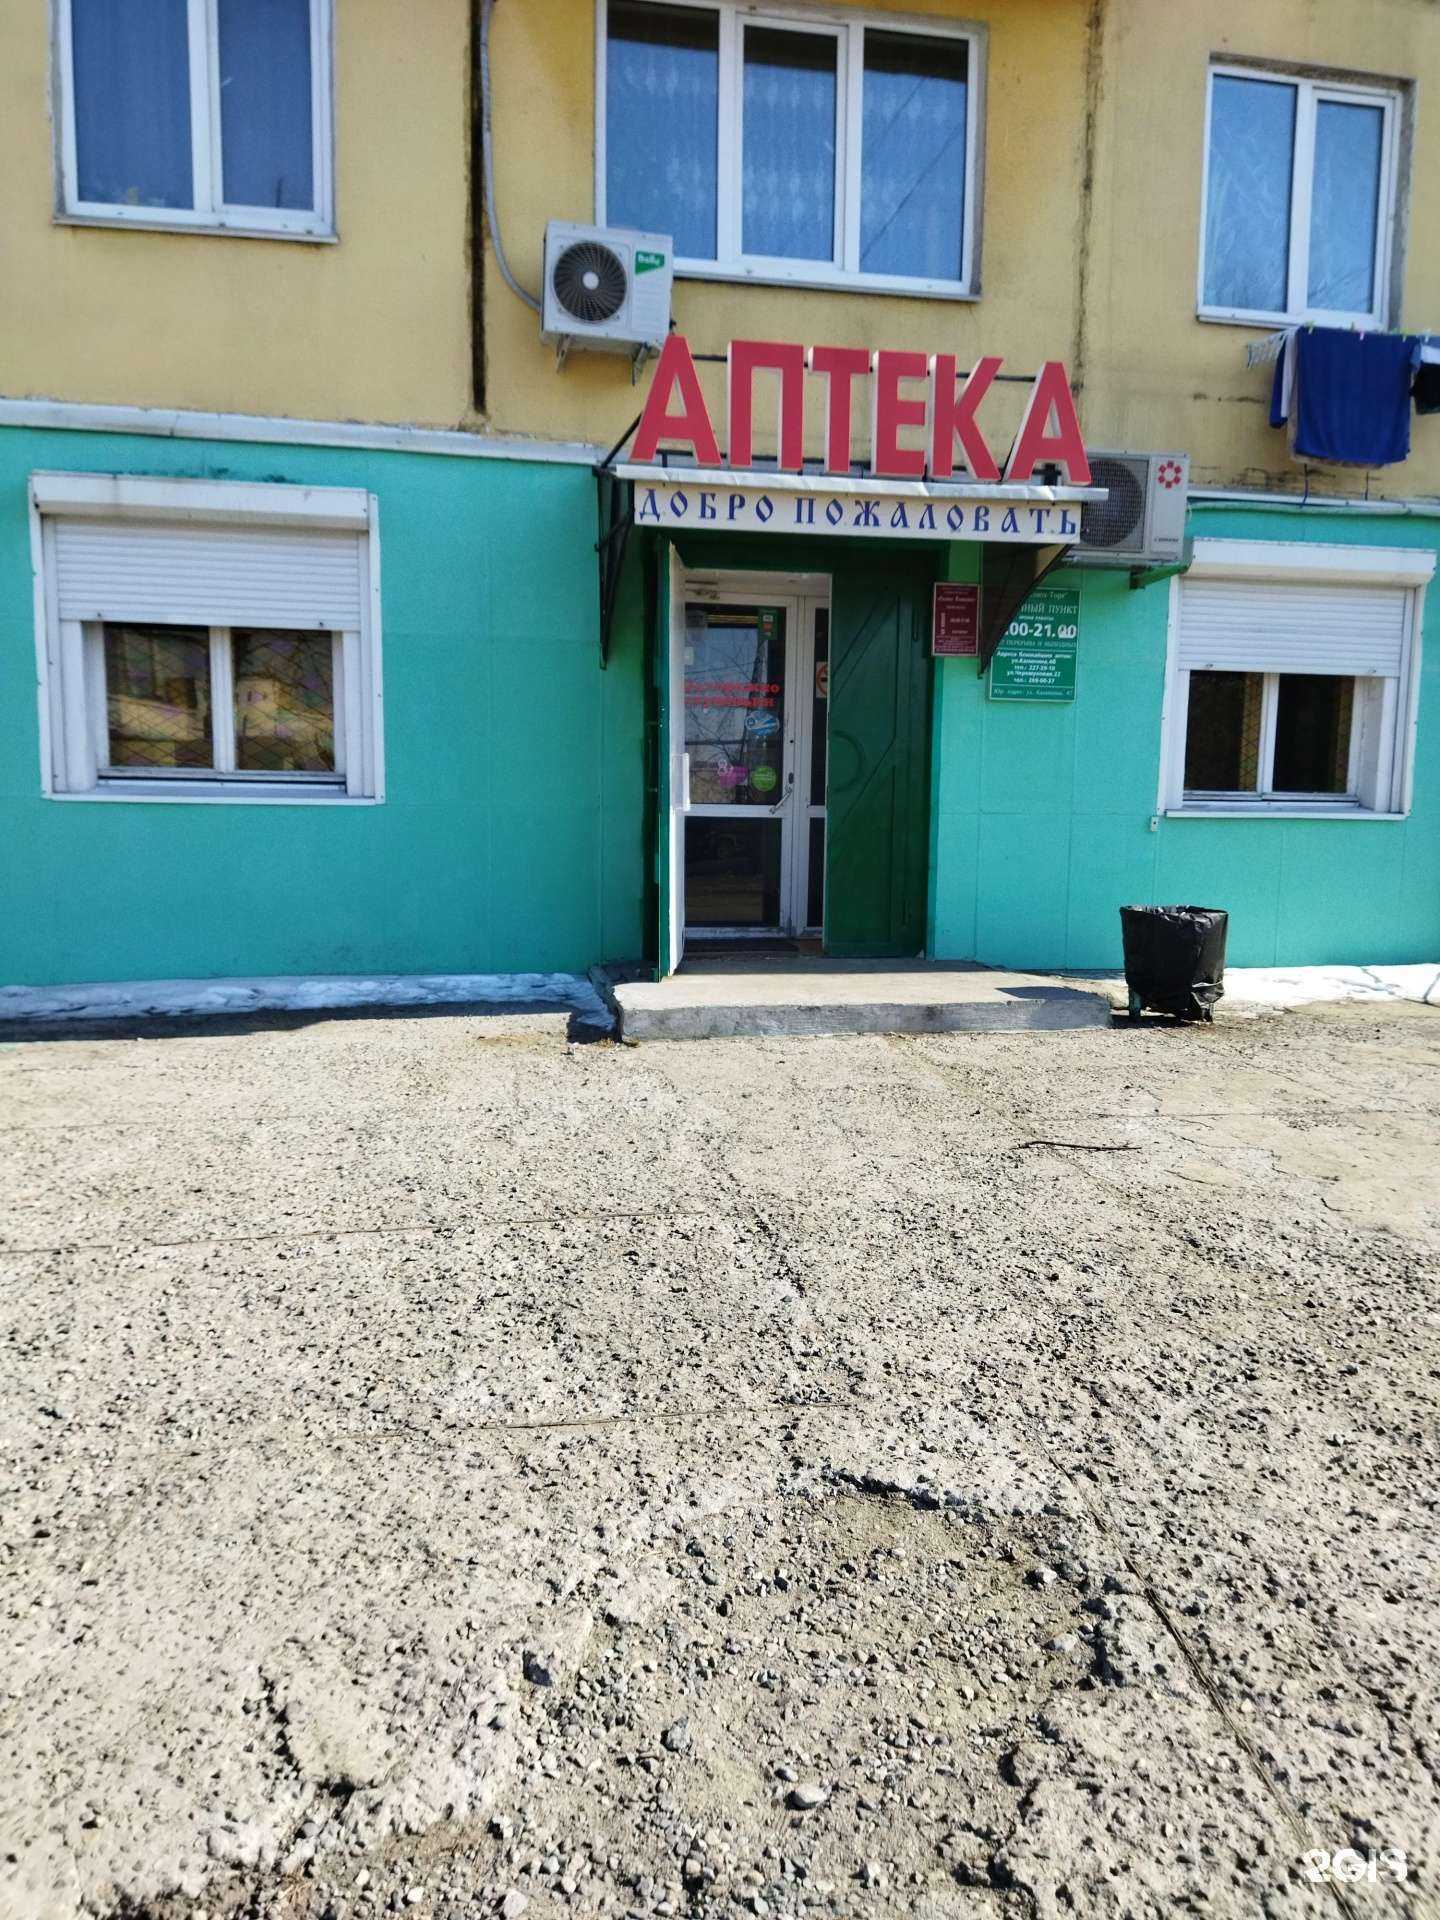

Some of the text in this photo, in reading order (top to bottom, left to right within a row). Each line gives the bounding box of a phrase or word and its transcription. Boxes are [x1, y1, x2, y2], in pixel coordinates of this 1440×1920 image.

[629, 334, 1092, 486] АПТЕКА
[639, 487, 1078, 537] ДОБРО ПОЖАЛОВАТЬ
[1048, 604, 1078, 615] ПУНКТ
[1004, 622, 1077, 639] .00-21.00
